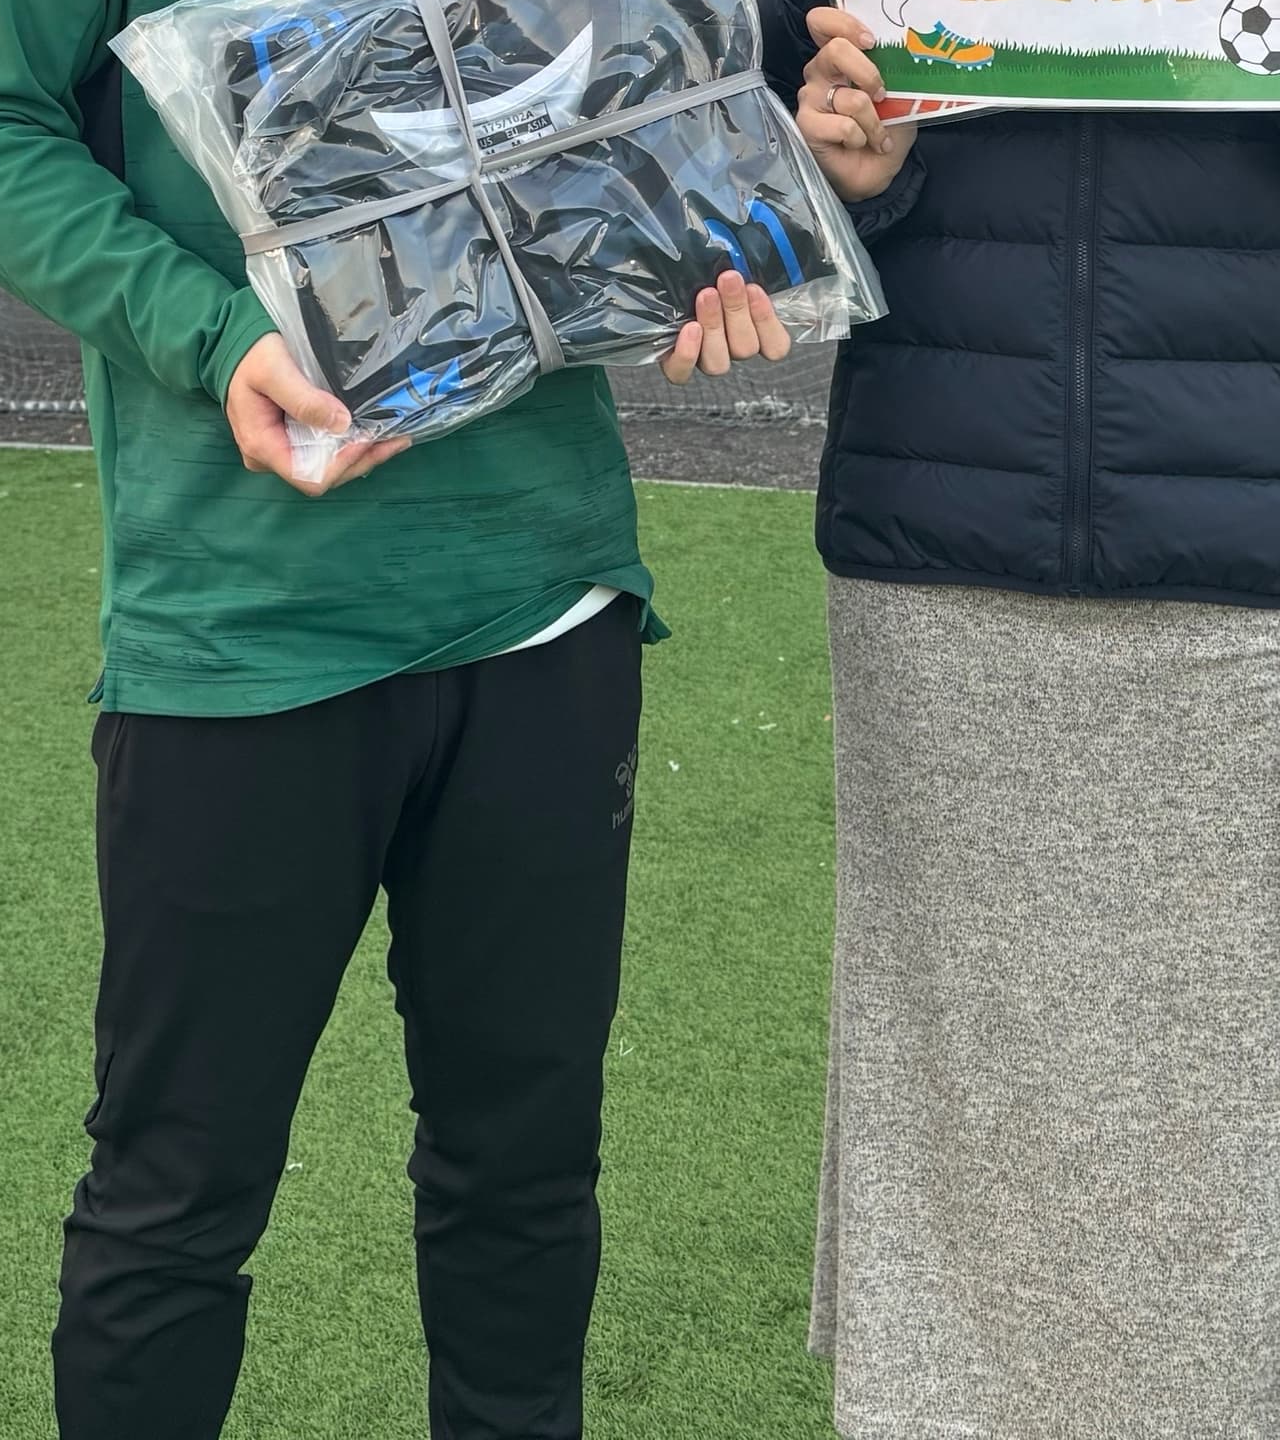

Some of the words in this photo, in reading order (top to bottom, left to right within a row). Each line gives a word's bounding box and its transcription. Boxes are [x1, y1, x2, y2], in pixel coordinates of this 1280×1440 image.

[479, 138, 494, 149] US
[527, 117, 549, 133] ASIA
[482, 109, 535, 134] 175/102A
